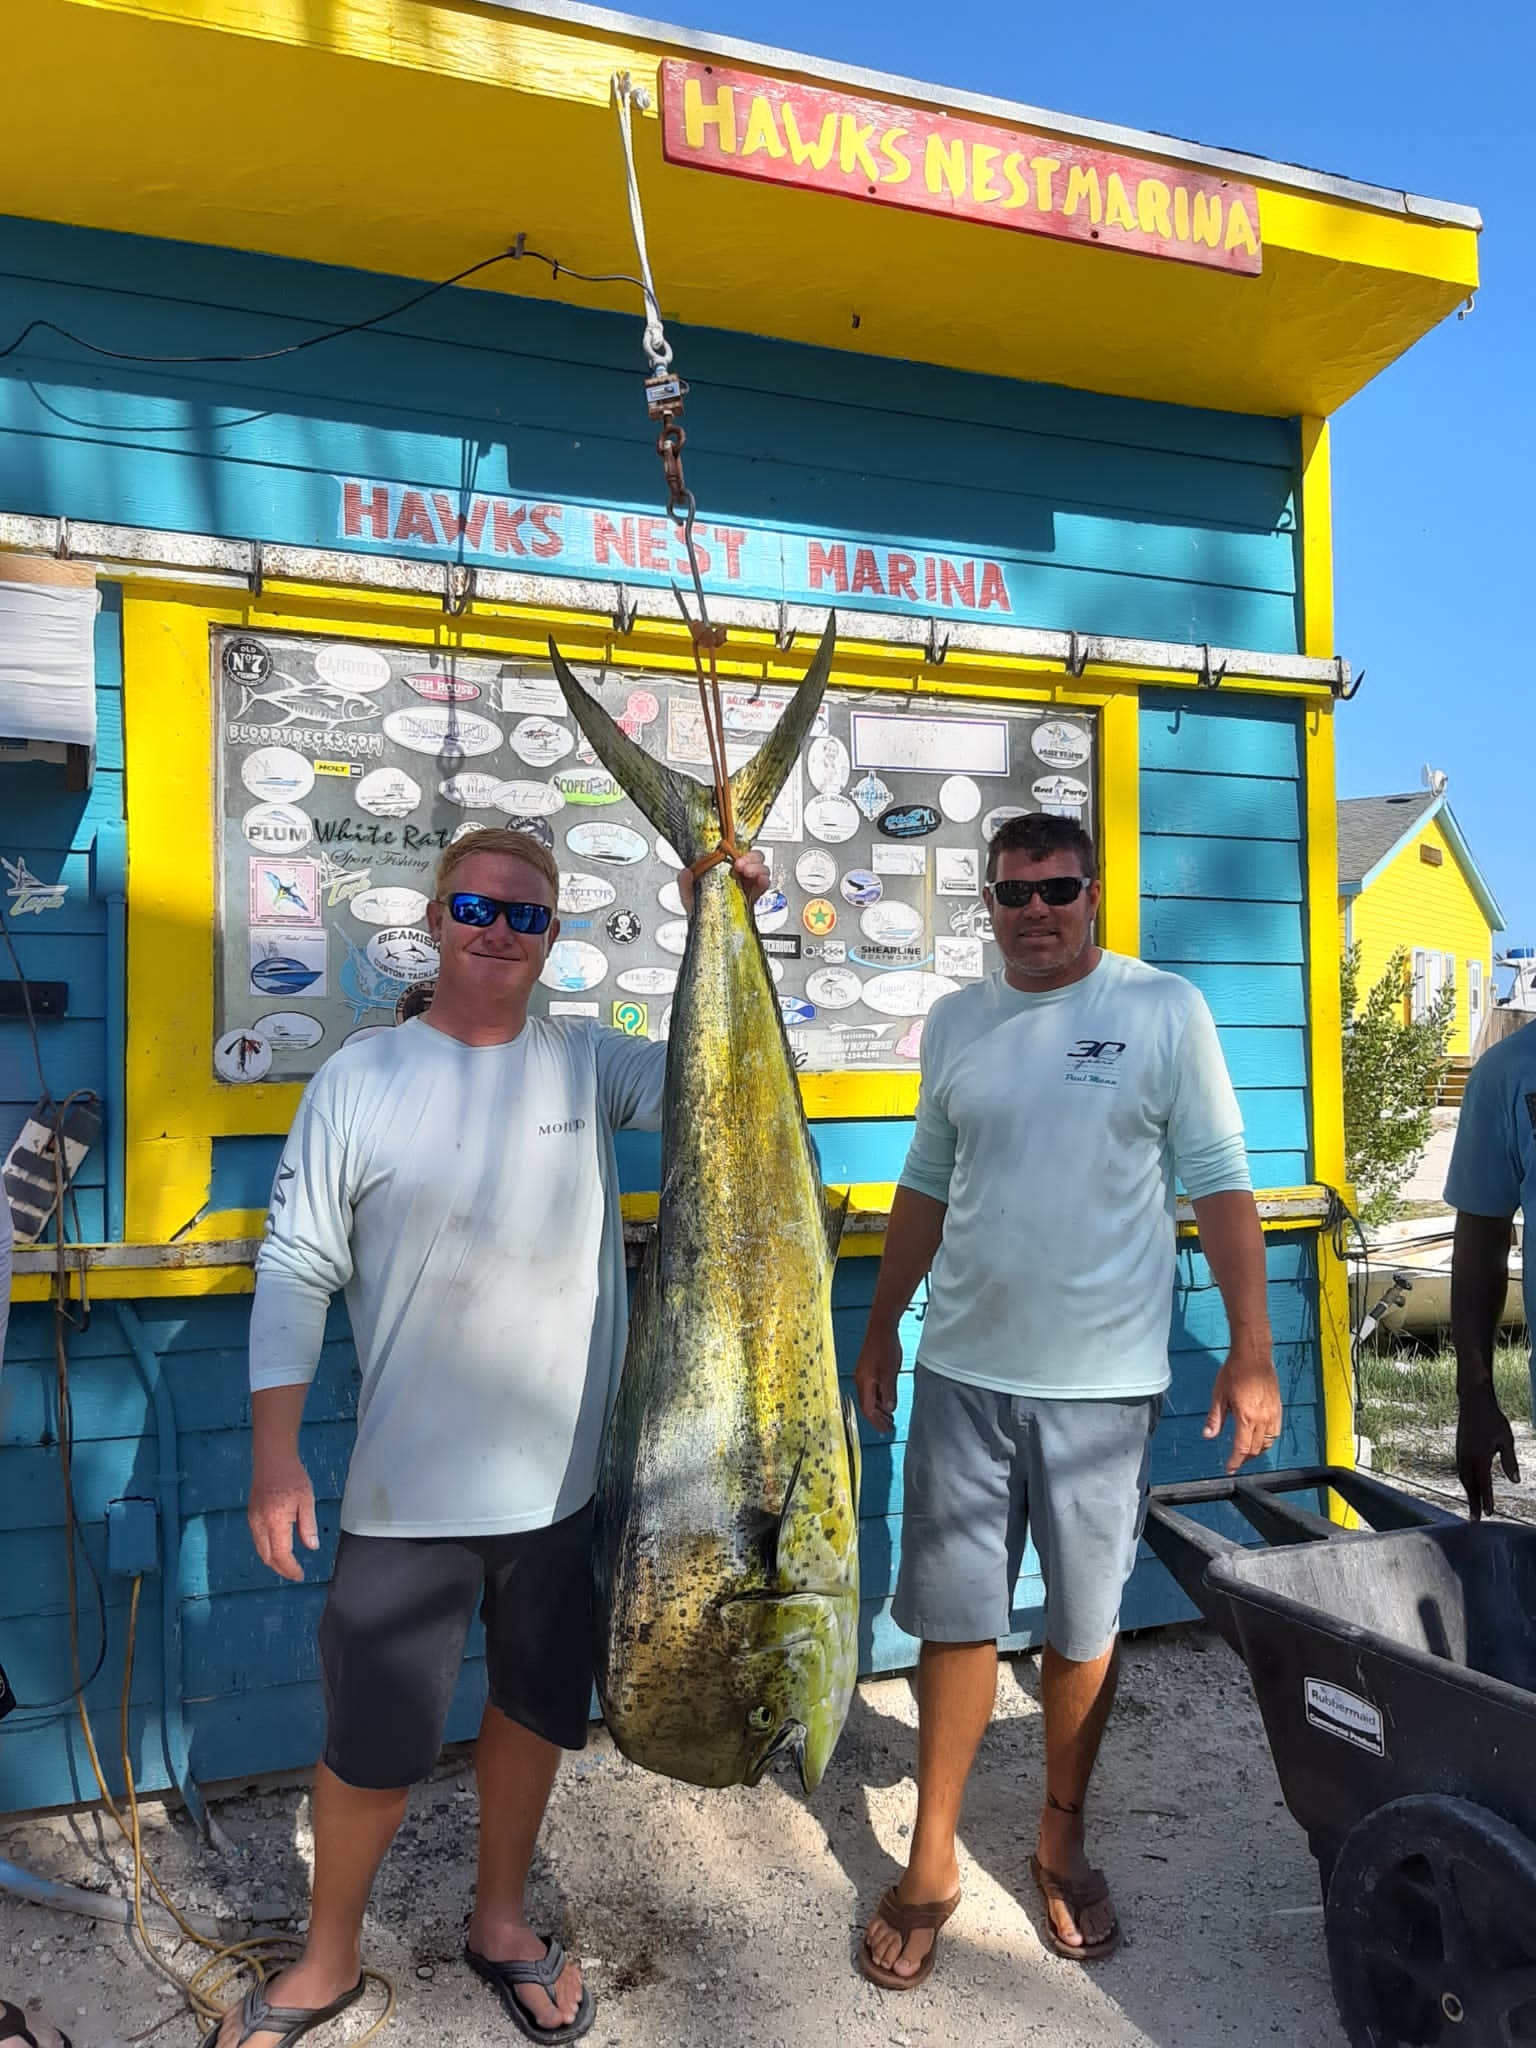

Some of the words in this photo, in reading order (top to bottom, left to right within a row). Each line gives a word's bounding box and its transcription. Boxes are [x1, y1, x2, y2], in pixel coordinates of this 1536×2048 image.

[684, 78, 912, 184] HAWKS
[924, 131, 1060, 210] NEST
[1064, 166, 1260, 256] MARINA
[343, 481, 564, 559] HAWKS
[592, 513, 747, 580] NEST
[807, 541, 1013, 612] MARINA
[240, 645, 257, 653] OLD
[318, 764, 348, 772] HOLT
[552, 775, 593, 794] SCOPED
[248, 825, 308, 842] PLUM
[313, 817, 398, 844] White
[402, 824, 449, 850] Rat
[329, 849, 373, 868] Sport
[376, 850, 432, 873] Fishing
[377, 930, 440, 954] BEAMISH
[860, 945, 921, 955] SHEARLINE
[374, 957, 405, 979] CUSTOM
[1311, 1688, 1376, 1726] Rubbermaid
